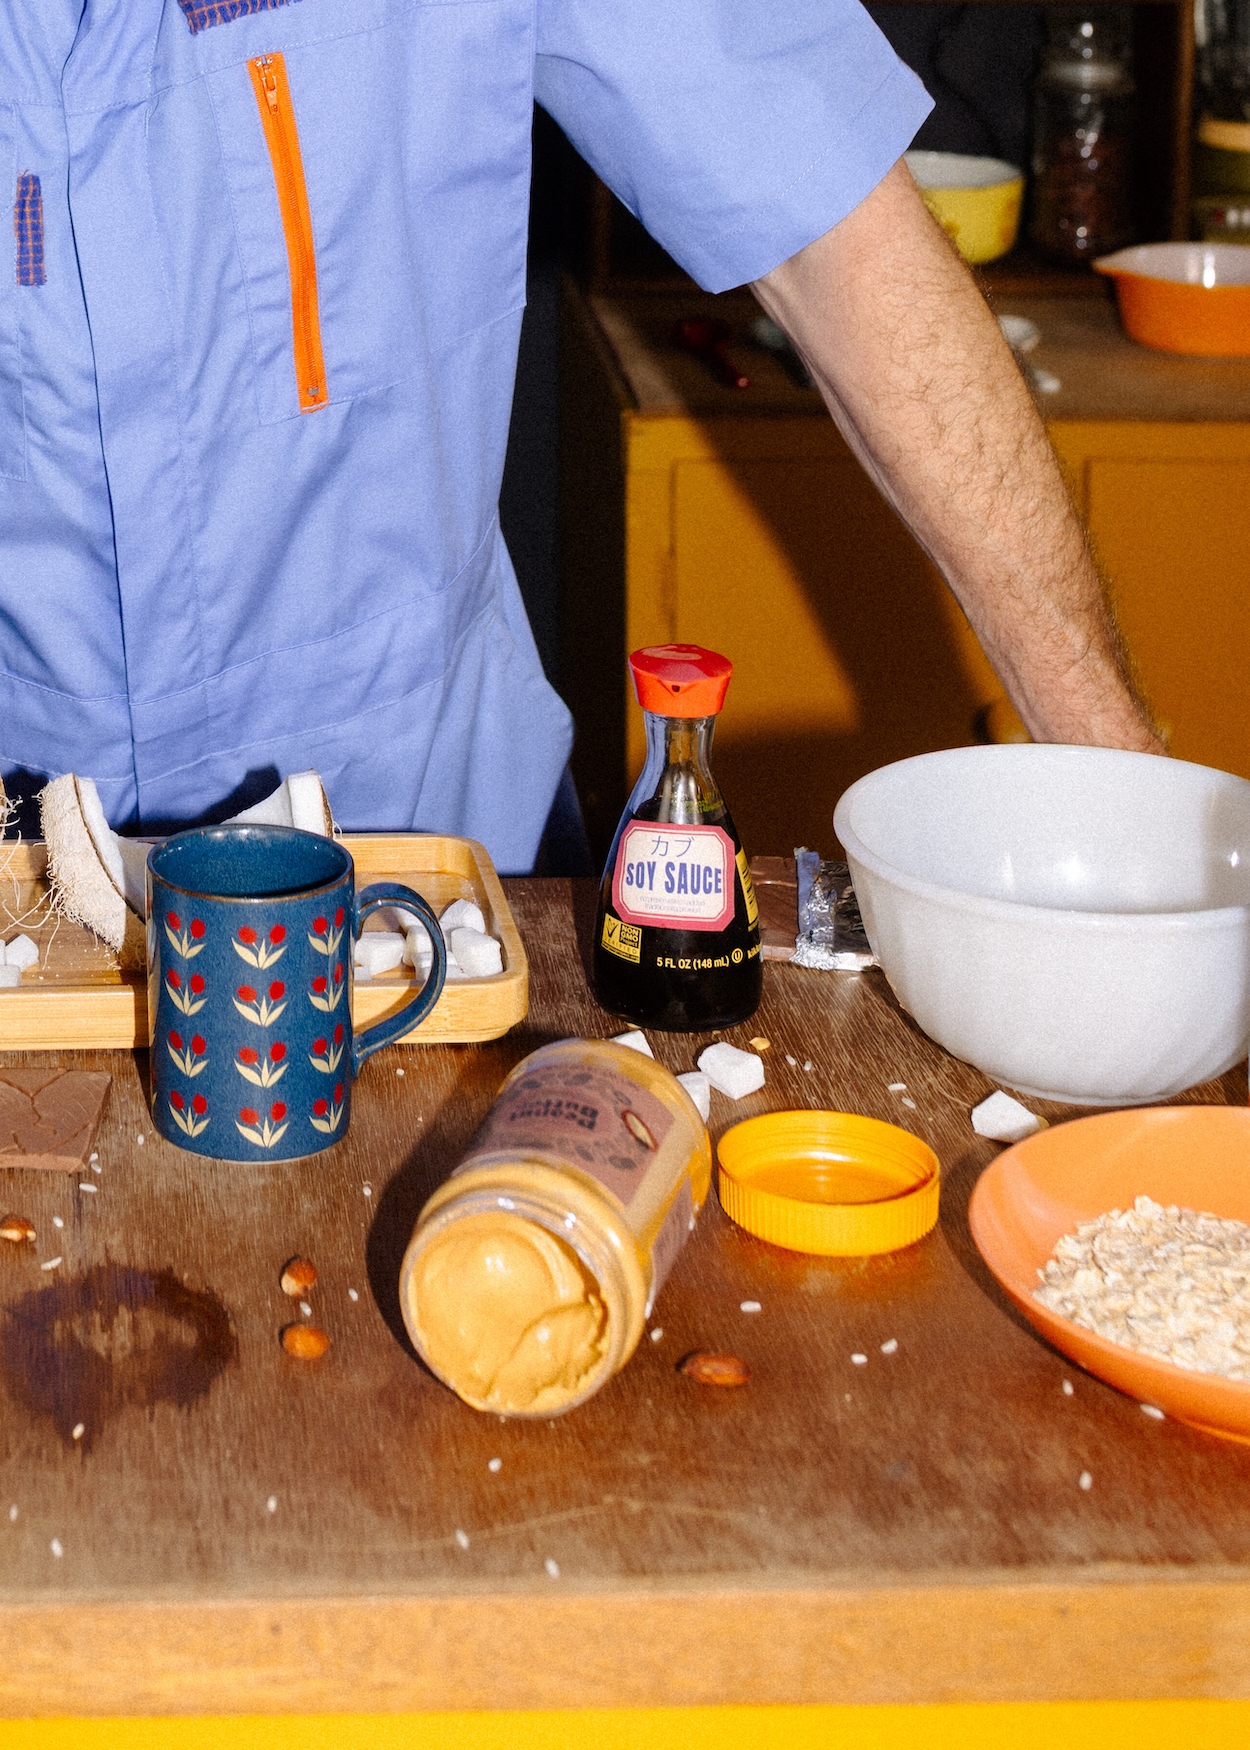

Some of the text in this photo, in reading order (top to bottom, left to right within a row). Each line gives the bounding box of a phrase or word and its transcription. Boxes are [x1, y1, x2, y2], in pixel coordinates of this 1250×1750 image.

[651, 835, 695, 858] カブ
[625, 861, 657, 891] SOY
[664, 861, 723, 895] SAUCE
[656, 954, 730, 971] 5 FL OZ (148 mL)
